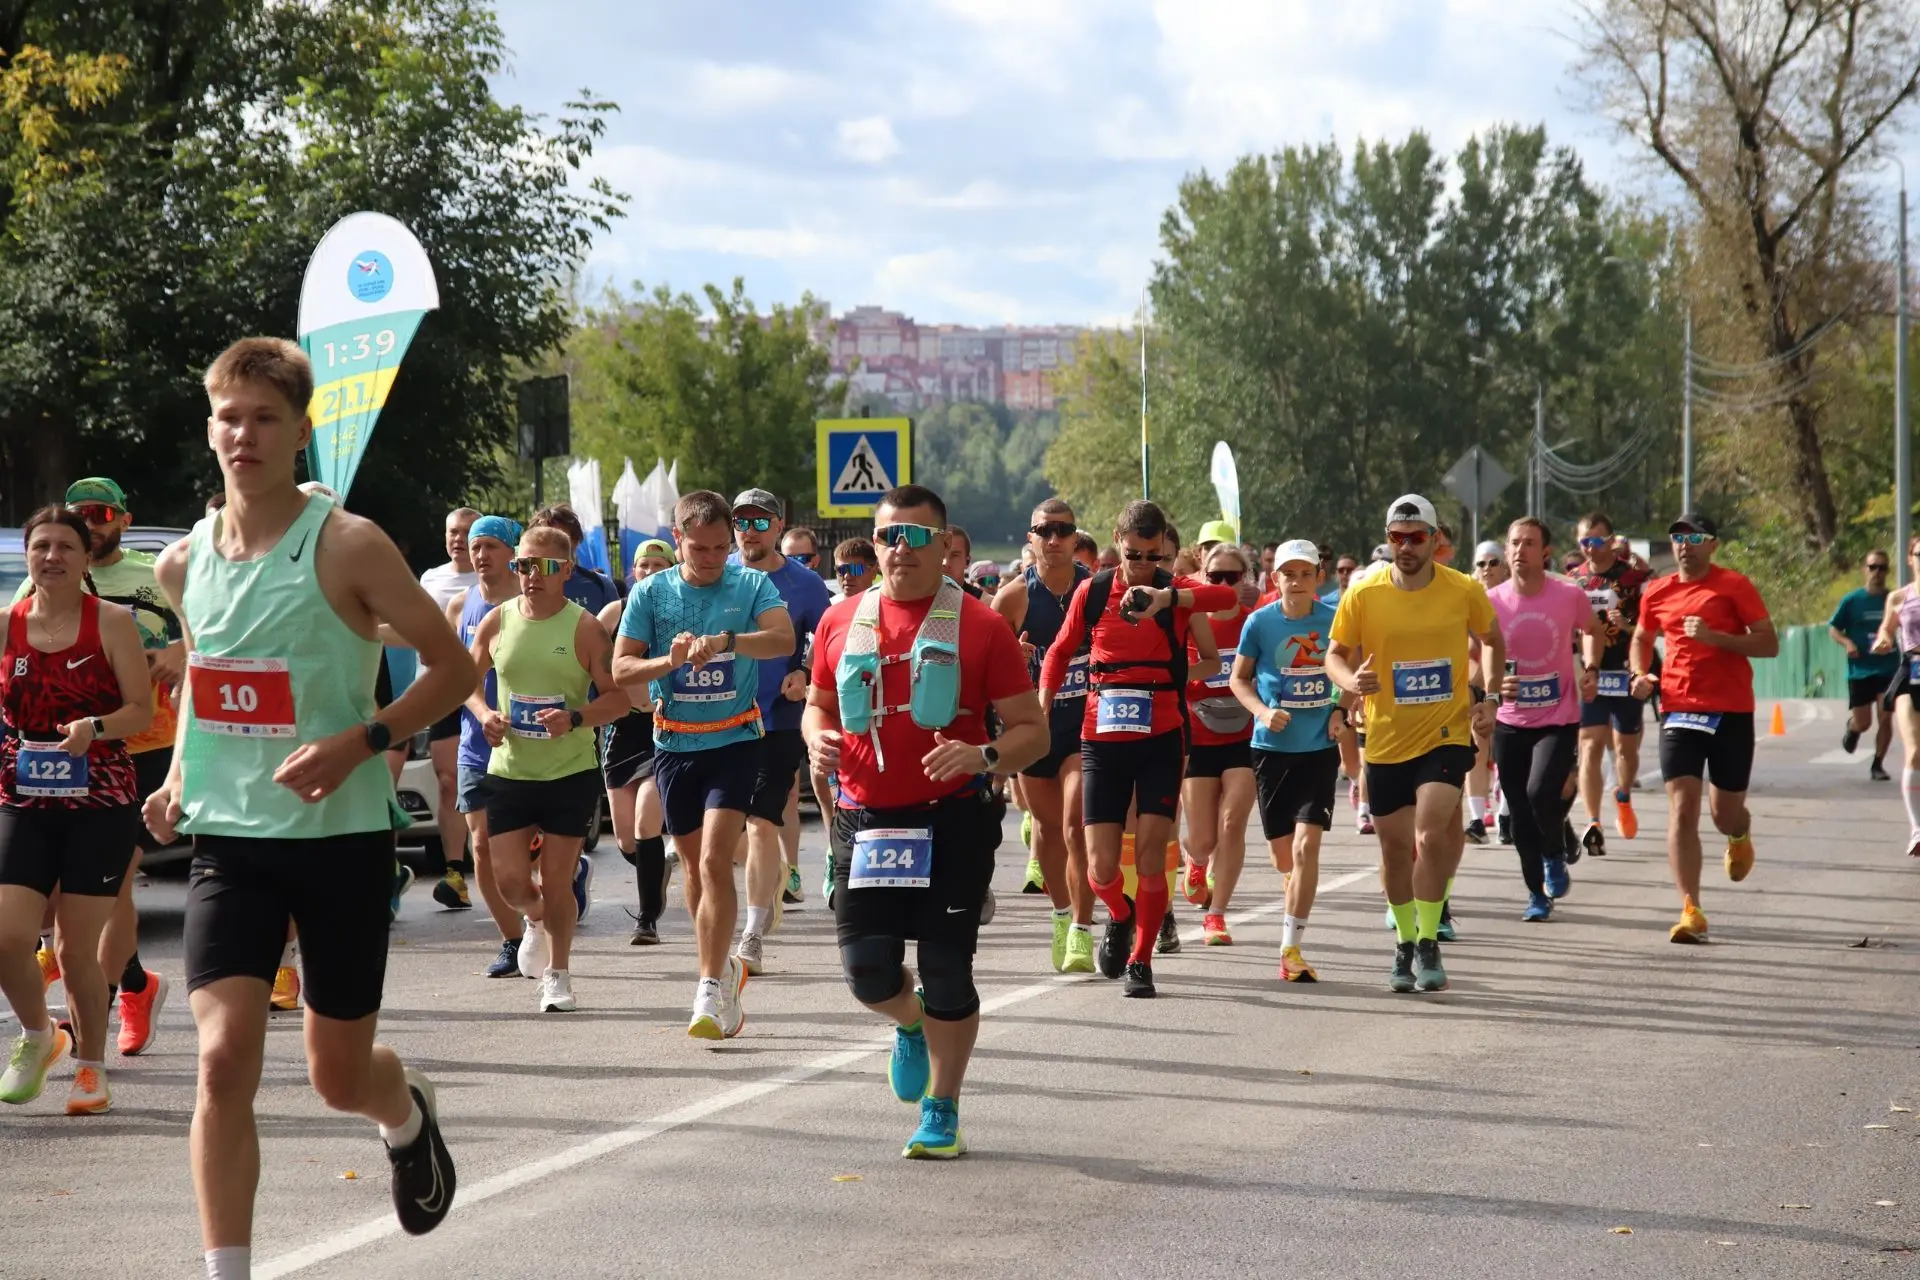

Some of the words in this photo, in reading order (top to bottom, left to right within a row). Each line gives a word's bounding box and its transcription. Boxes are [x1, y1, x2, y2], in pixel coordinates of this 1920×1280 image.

[324, 329, 395, 368] 1:39
[322, 382, 365, 418] 21.1
[685, 669, 725, 687] 189
[1061, 670, 1085, 687] 78
[1406, 674, 1441, 691] 212
[1293, 681, 1325, 696] 126
[1521, 685, 1551, 698] 136
[219, 684, 258, 712] 10
[520, 709, 544, 726] 11
[1106, 703, 1140, 719] 132
[28, 760, 71, 780] 122
[866, 848, 914, 869] 124
